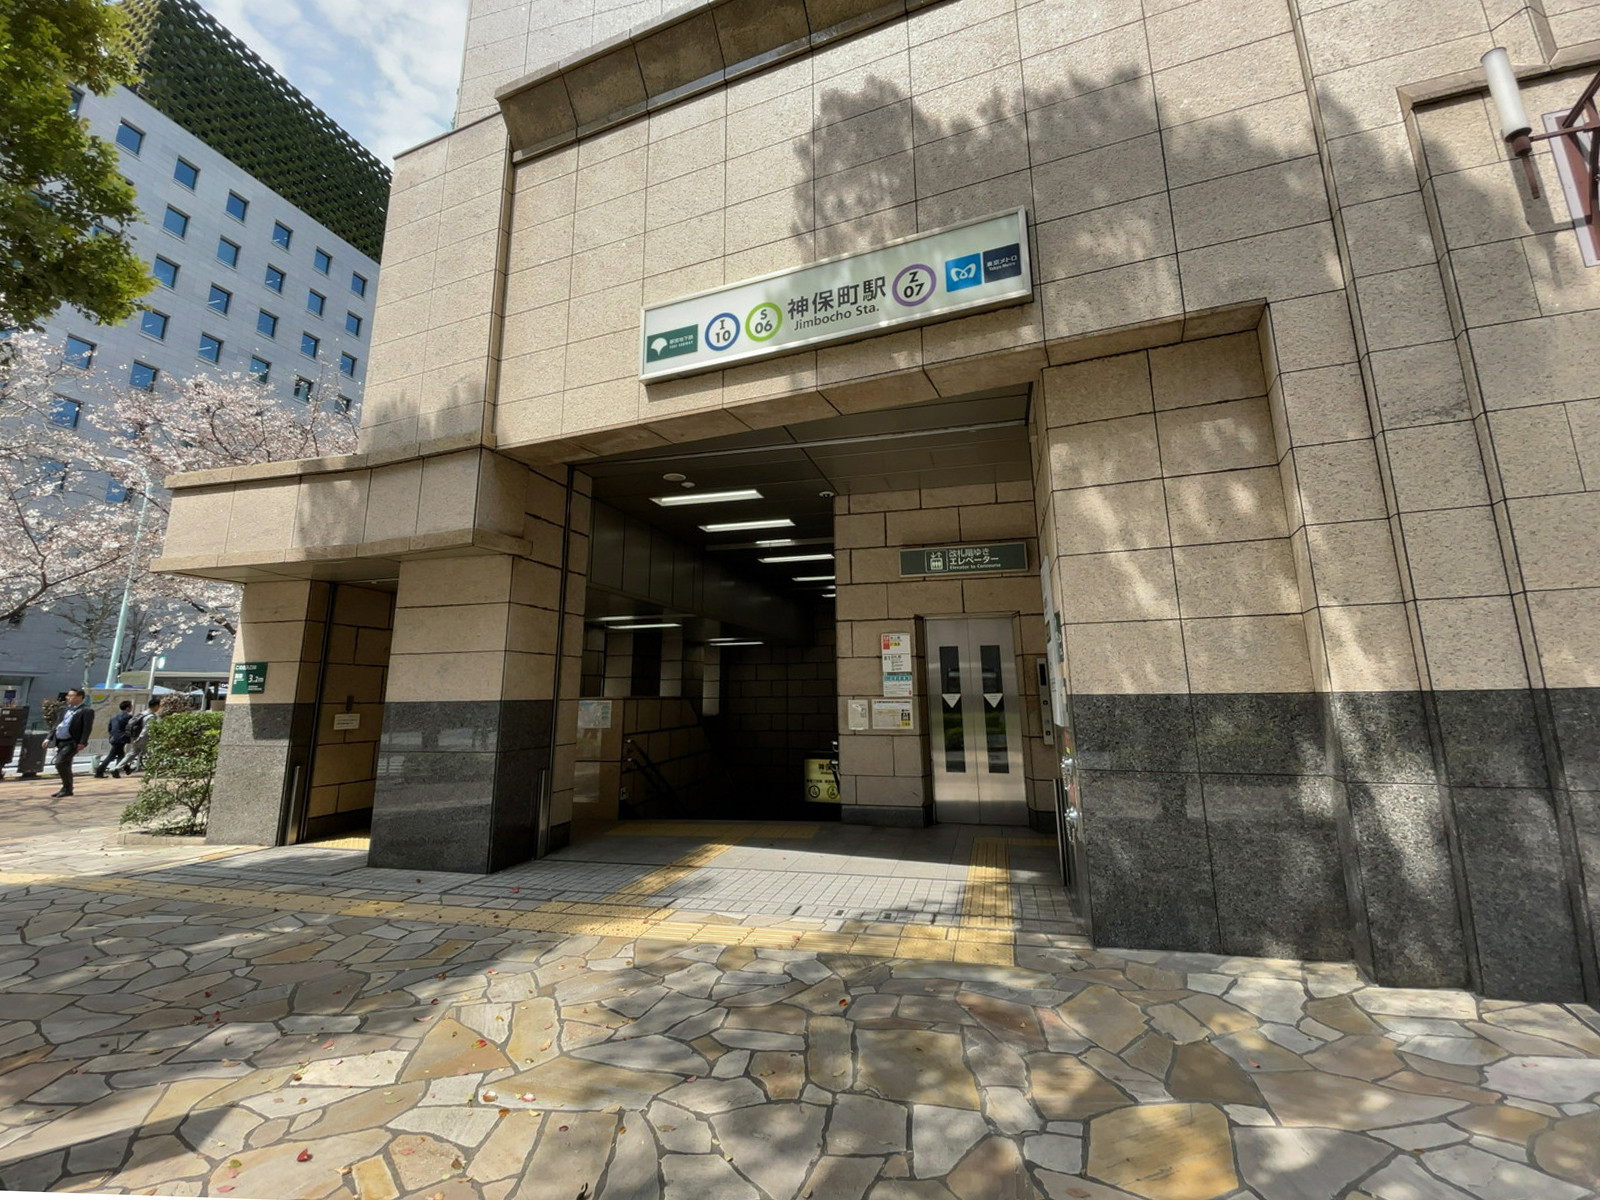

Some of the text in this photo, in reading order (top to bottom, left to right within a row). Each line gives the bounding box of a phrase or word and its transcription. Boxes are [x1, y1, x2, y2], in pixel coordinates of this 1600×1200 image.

[986, 255, 1017, 267] 東京メトロ
[908, 270, 919, 284] Z
[903, 282, 925, 299] 07
[787, 275, 887, 320] 神保町駅
[760, 308, 768, 320] S
[793, 303, 880, 331] Jimbocho Sta.
[719, 319, 725, 330] I
[754, 320, 773, 334] 06
[715, 330, 731, 343] 10
[948, 555, 999, 566] エレベーター
[247, 674, 264, 683] 3.2m
